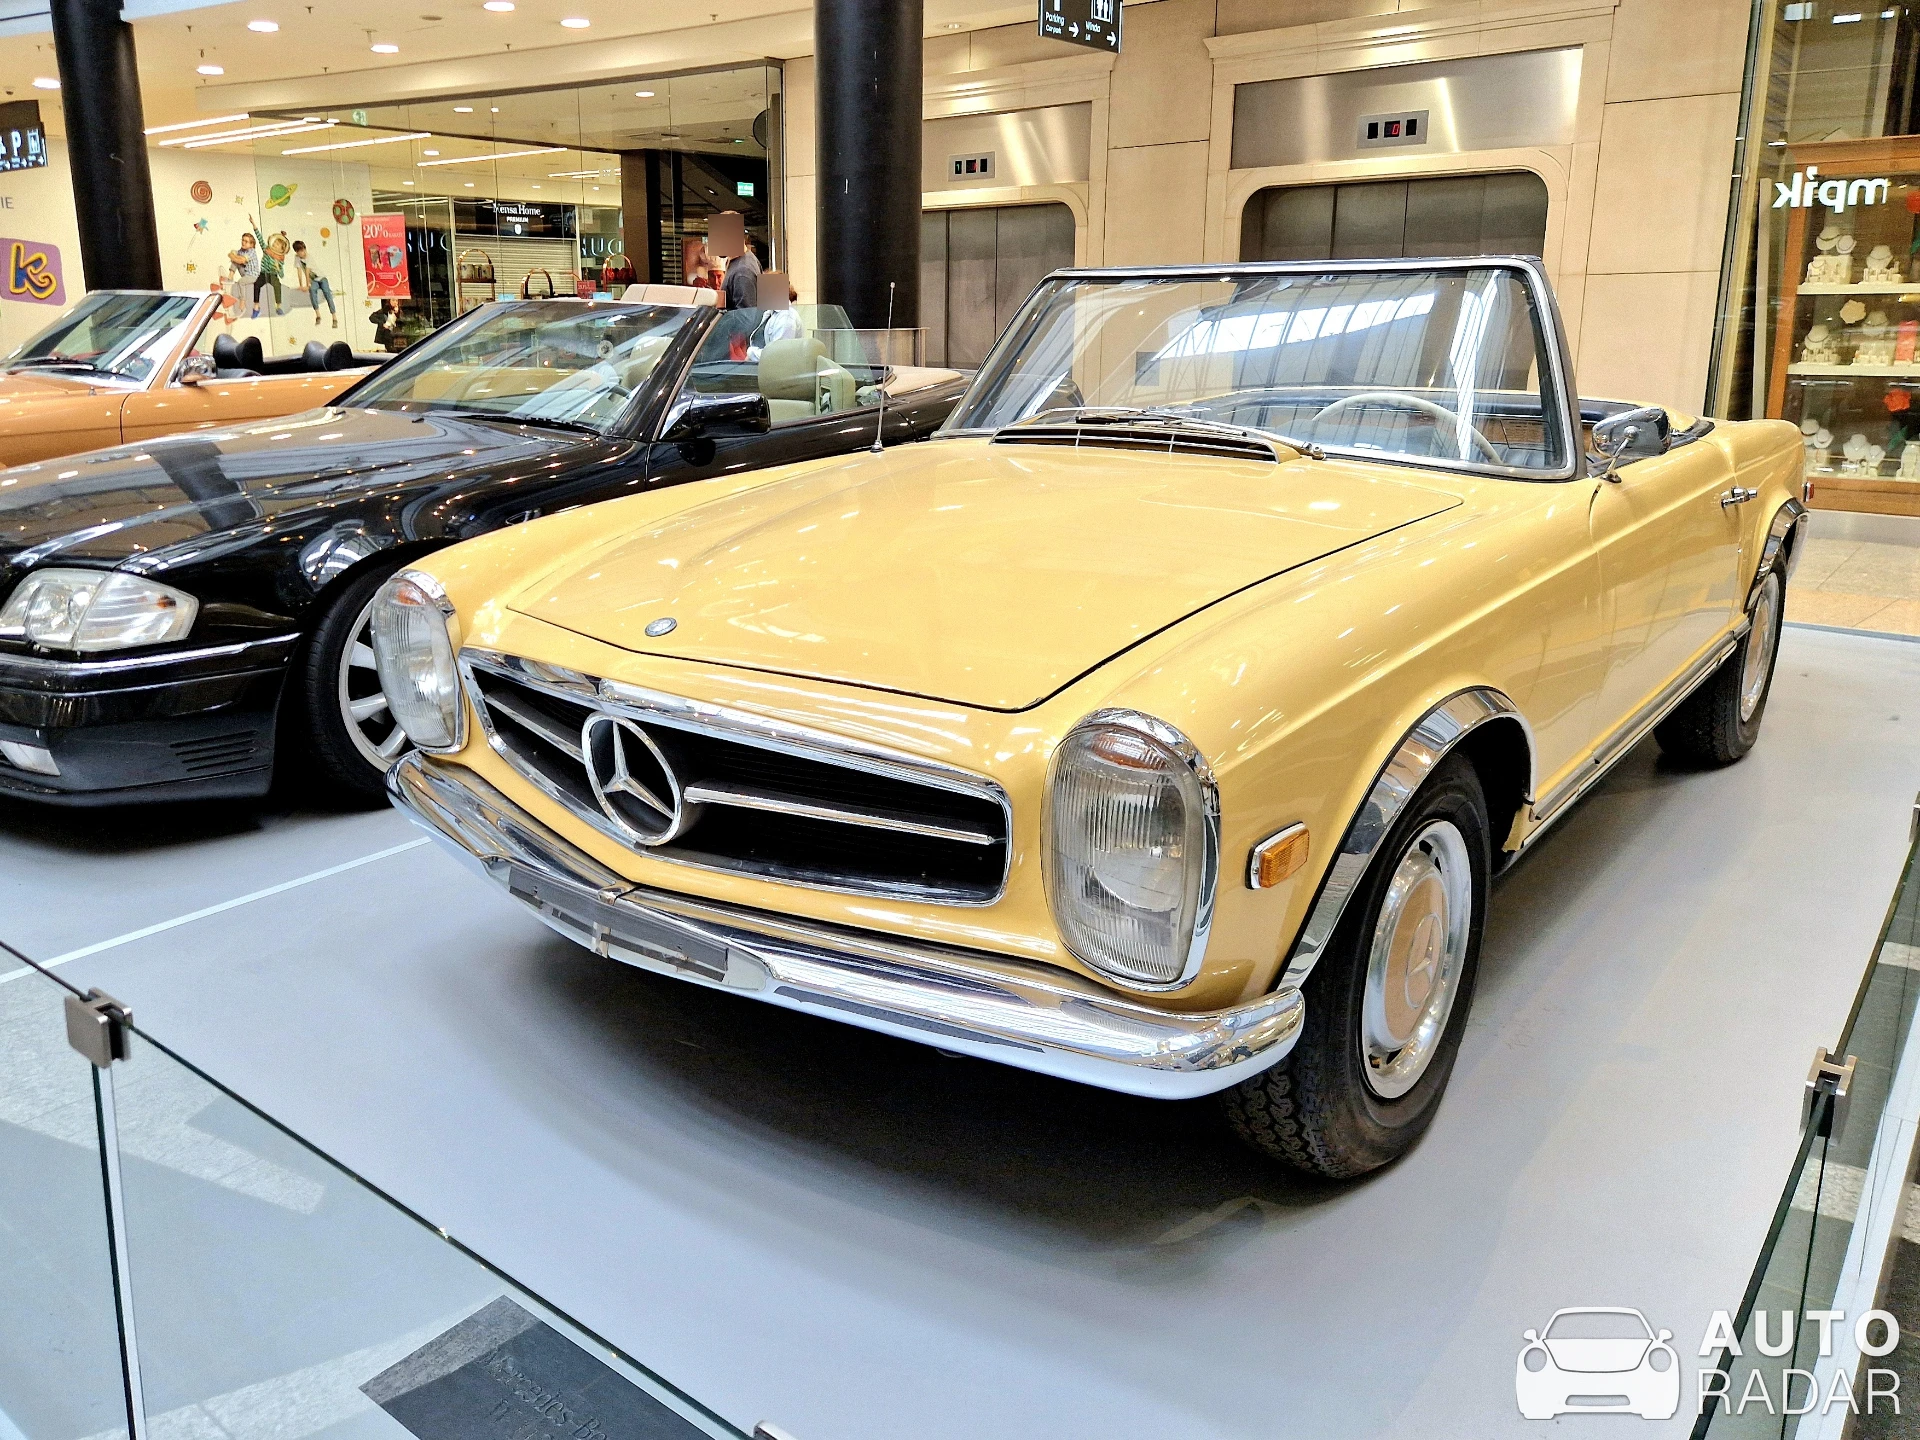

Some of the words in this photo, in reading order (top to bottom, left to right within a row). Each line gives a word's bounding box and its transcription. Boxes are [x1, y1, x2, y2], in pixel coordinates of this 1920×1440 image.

[1045, 12, 1065, 26] Parking
[1085, 21, 1101, 32] Winda
[518, 204, 541, 216] Home
